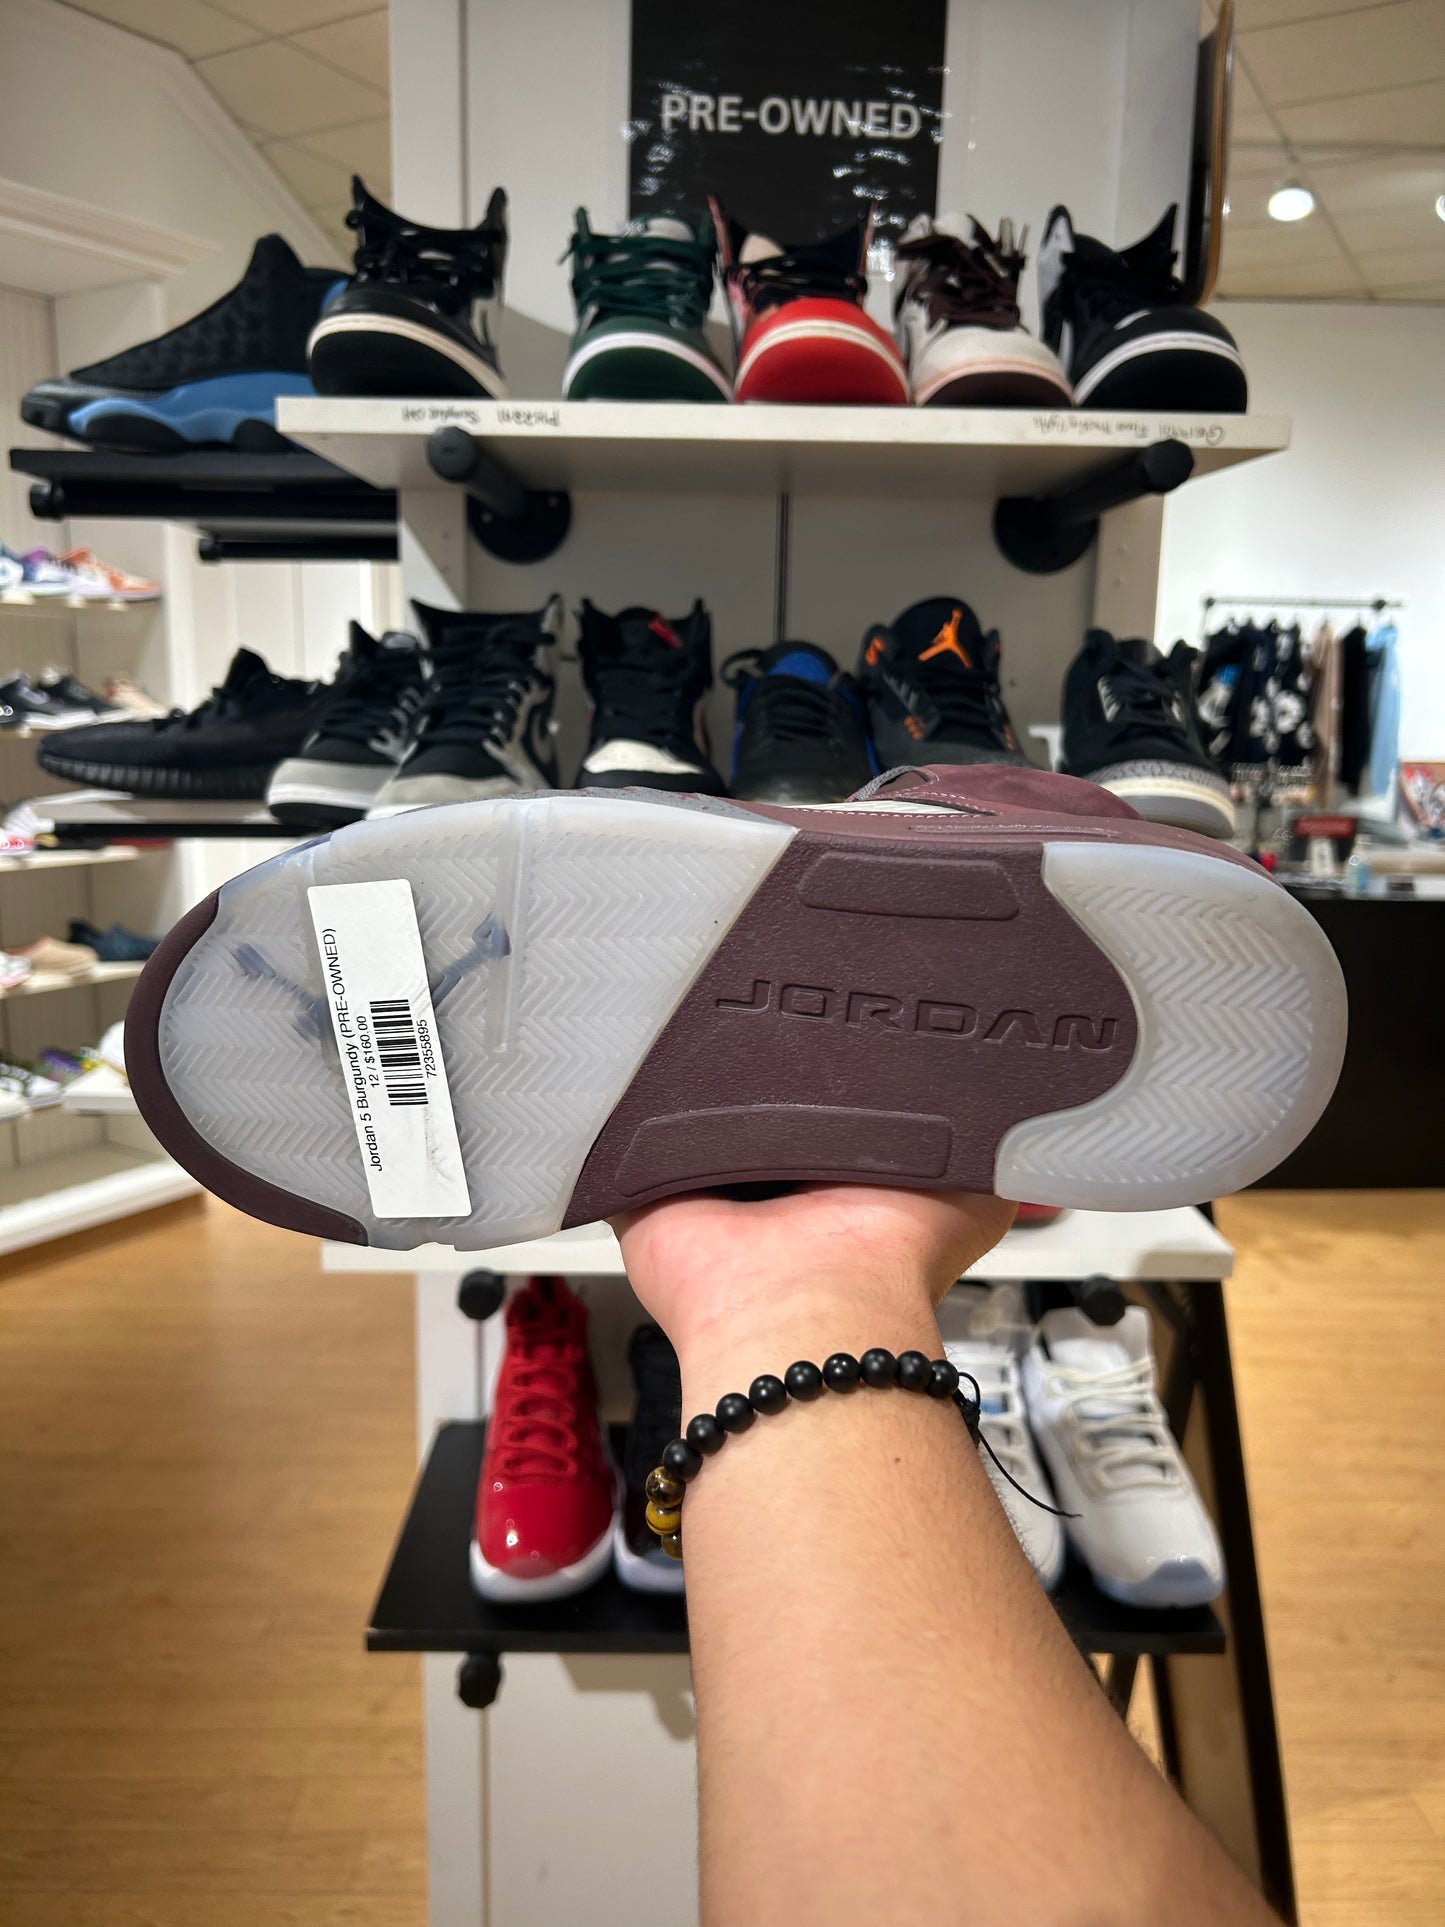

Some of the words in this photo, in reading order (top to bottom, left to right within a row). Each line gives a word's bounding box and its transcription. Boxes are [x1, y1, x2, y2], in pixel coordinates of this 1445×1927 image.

[661, 94, 921, 139] PRE-OWNED
[322, 928, 356, 1038] (PRE-OWNED)
[356, 1015, 376, 1064] $160.00
[716, 979, 1119, 1053] JORDAN
[416, 1019, 438, 1078] 72355895
[345, 1042, 370, 1109] Burgundy
[368, 1074, 380, 1088] 12
[360, 1112, 372, 1121] 5
[364, 1125, 382, 1171] Jordan
